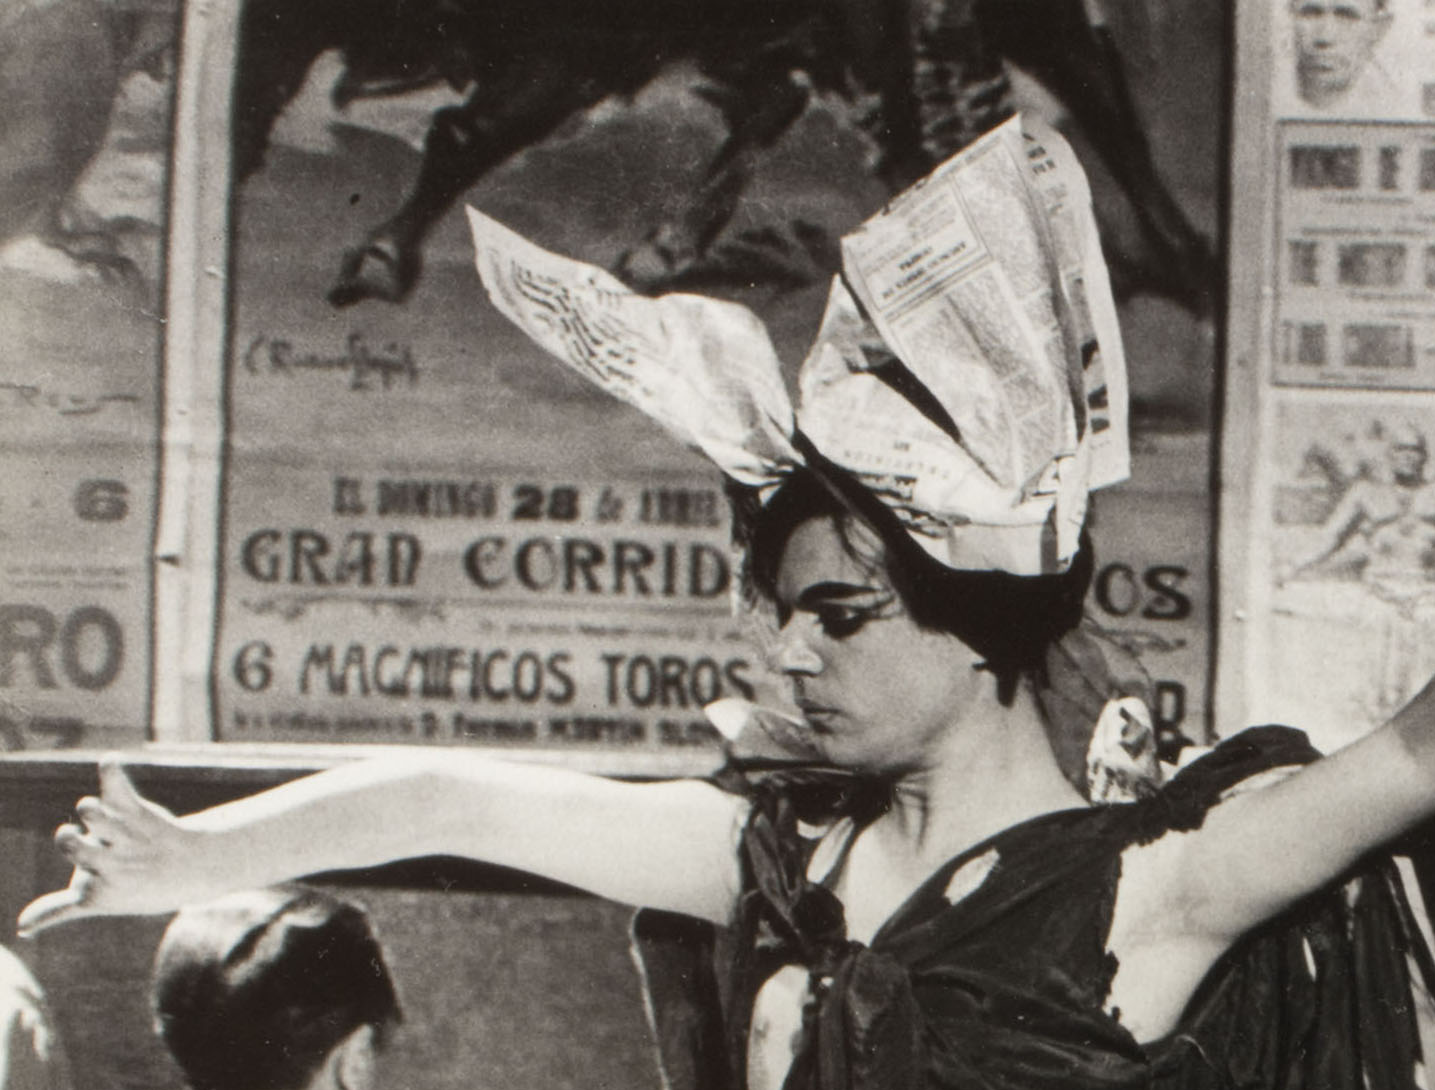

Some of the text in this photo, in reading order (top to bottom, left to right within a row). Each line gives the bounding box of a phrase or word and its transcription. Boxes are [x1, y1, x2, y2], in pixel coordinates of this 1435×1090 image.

[73, 478, 131, 523] 6
[512, 484, 579, 521] 28
[463, 536, 732, 597] CORRID
[232, 641, 274, 692] 6
[600, 654, 756, 709] TOROS
